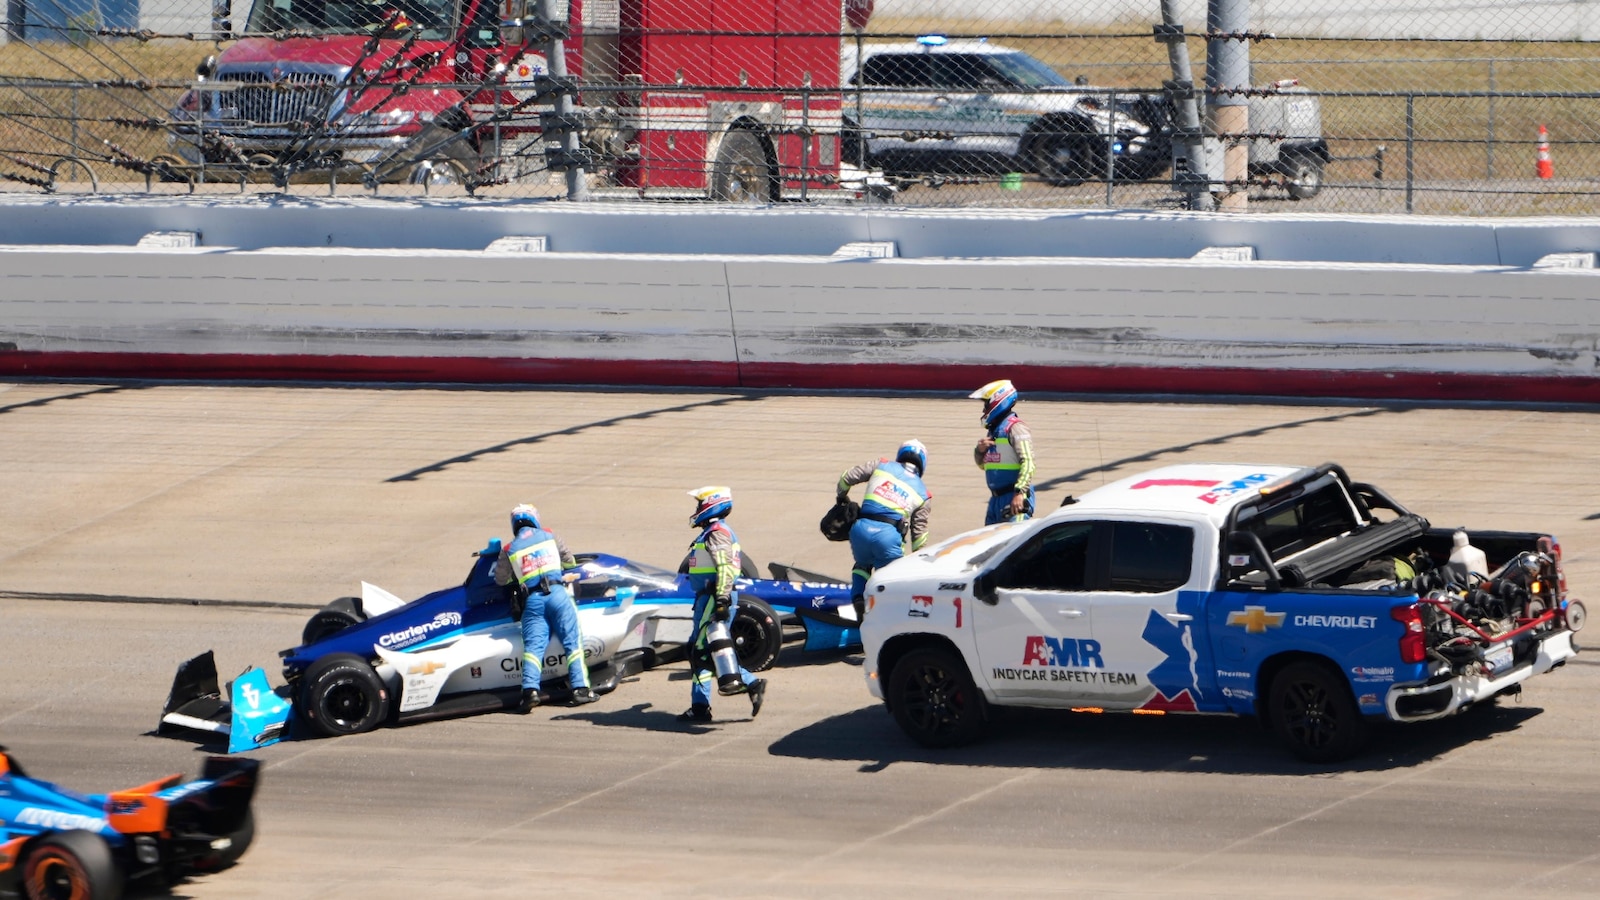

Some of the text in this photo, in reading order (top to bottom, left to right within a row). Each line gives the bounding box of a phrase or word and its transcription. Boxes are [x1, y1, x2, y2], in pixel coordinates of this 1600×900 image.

[953, 597, 962, 628] 1
[1294, 615, 1378, 629] CHEVROLET
[1022, 635, 1105, 668] AMR
[993, 668, 1138, 686] INDYCAR SAFETY TEAM
